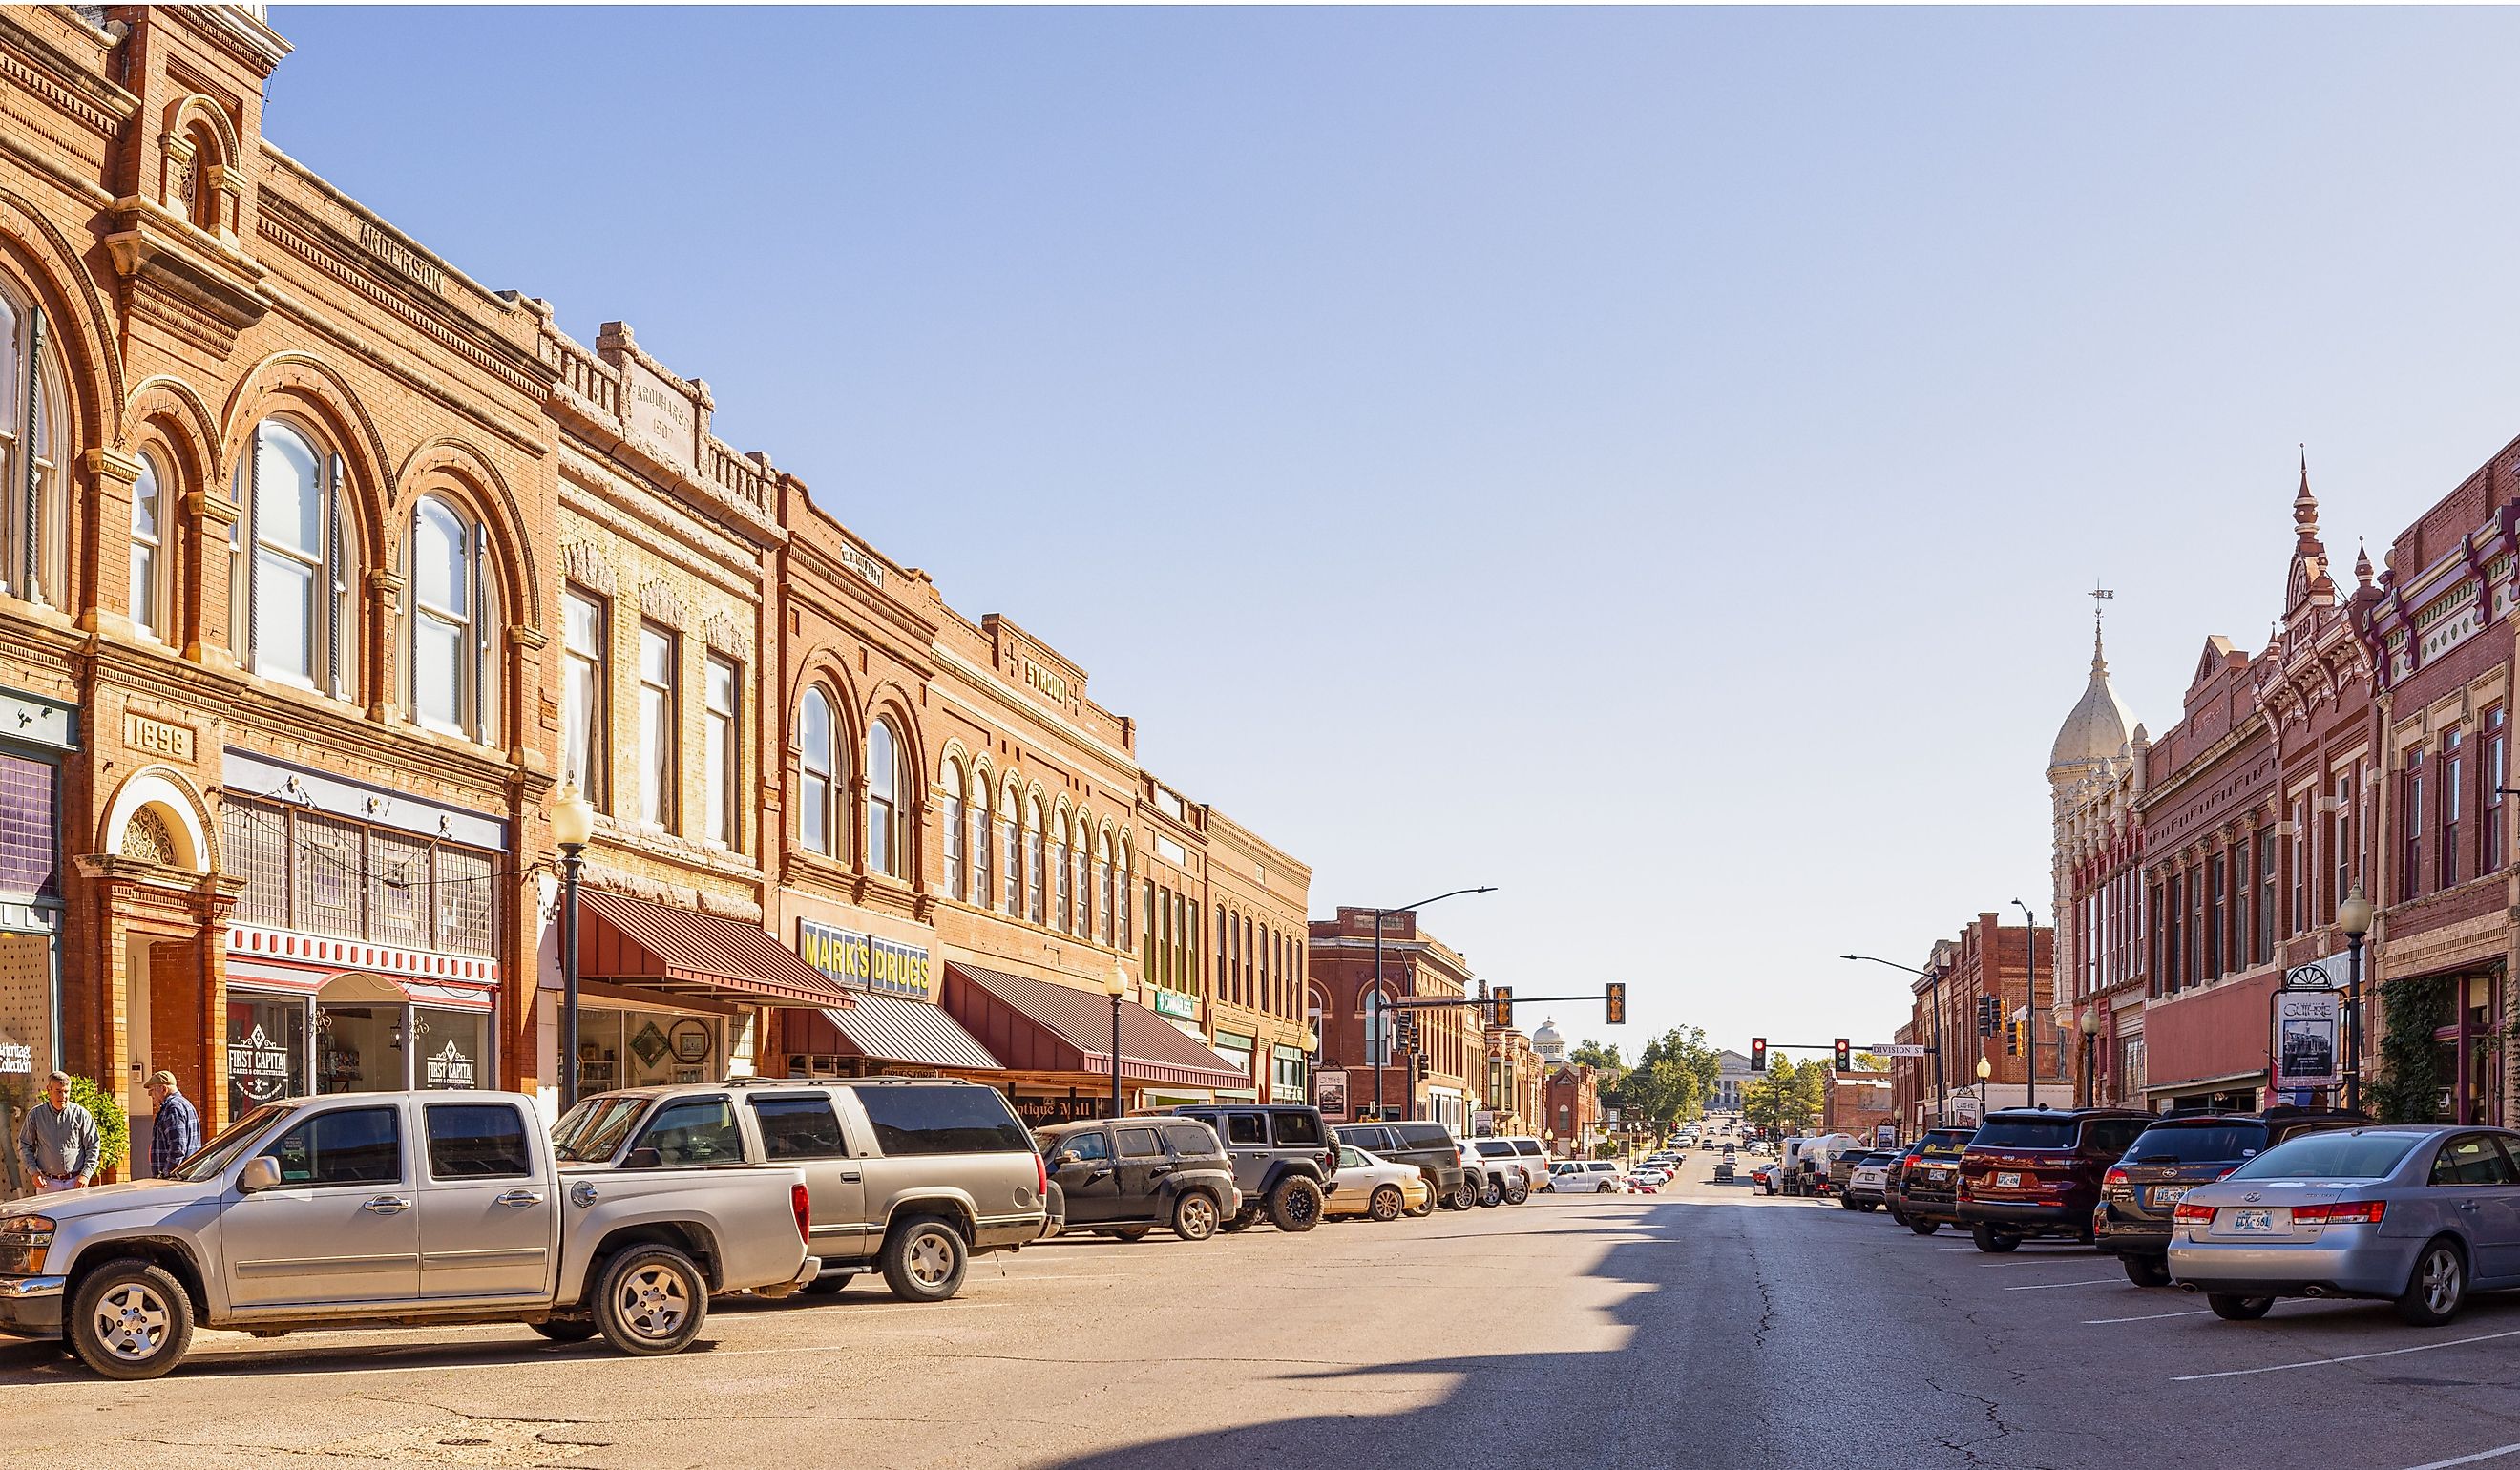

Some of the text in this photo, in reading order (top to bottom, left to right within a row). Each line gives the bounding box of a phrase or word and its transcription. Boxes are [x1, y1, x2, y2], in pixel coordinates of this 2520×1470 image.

[357, 221, 445, 297] ANDERSON
[134, 718, 183, 755] 1898
[805, 932, 929, 989] MARK'S DRUGS
[228, 1049, 288, 1077] FIRST CAPITAL
[427, 1061, 474, 1085] FIRST CAPITAL
[1017, 1102, 1055, 1119] ntique
